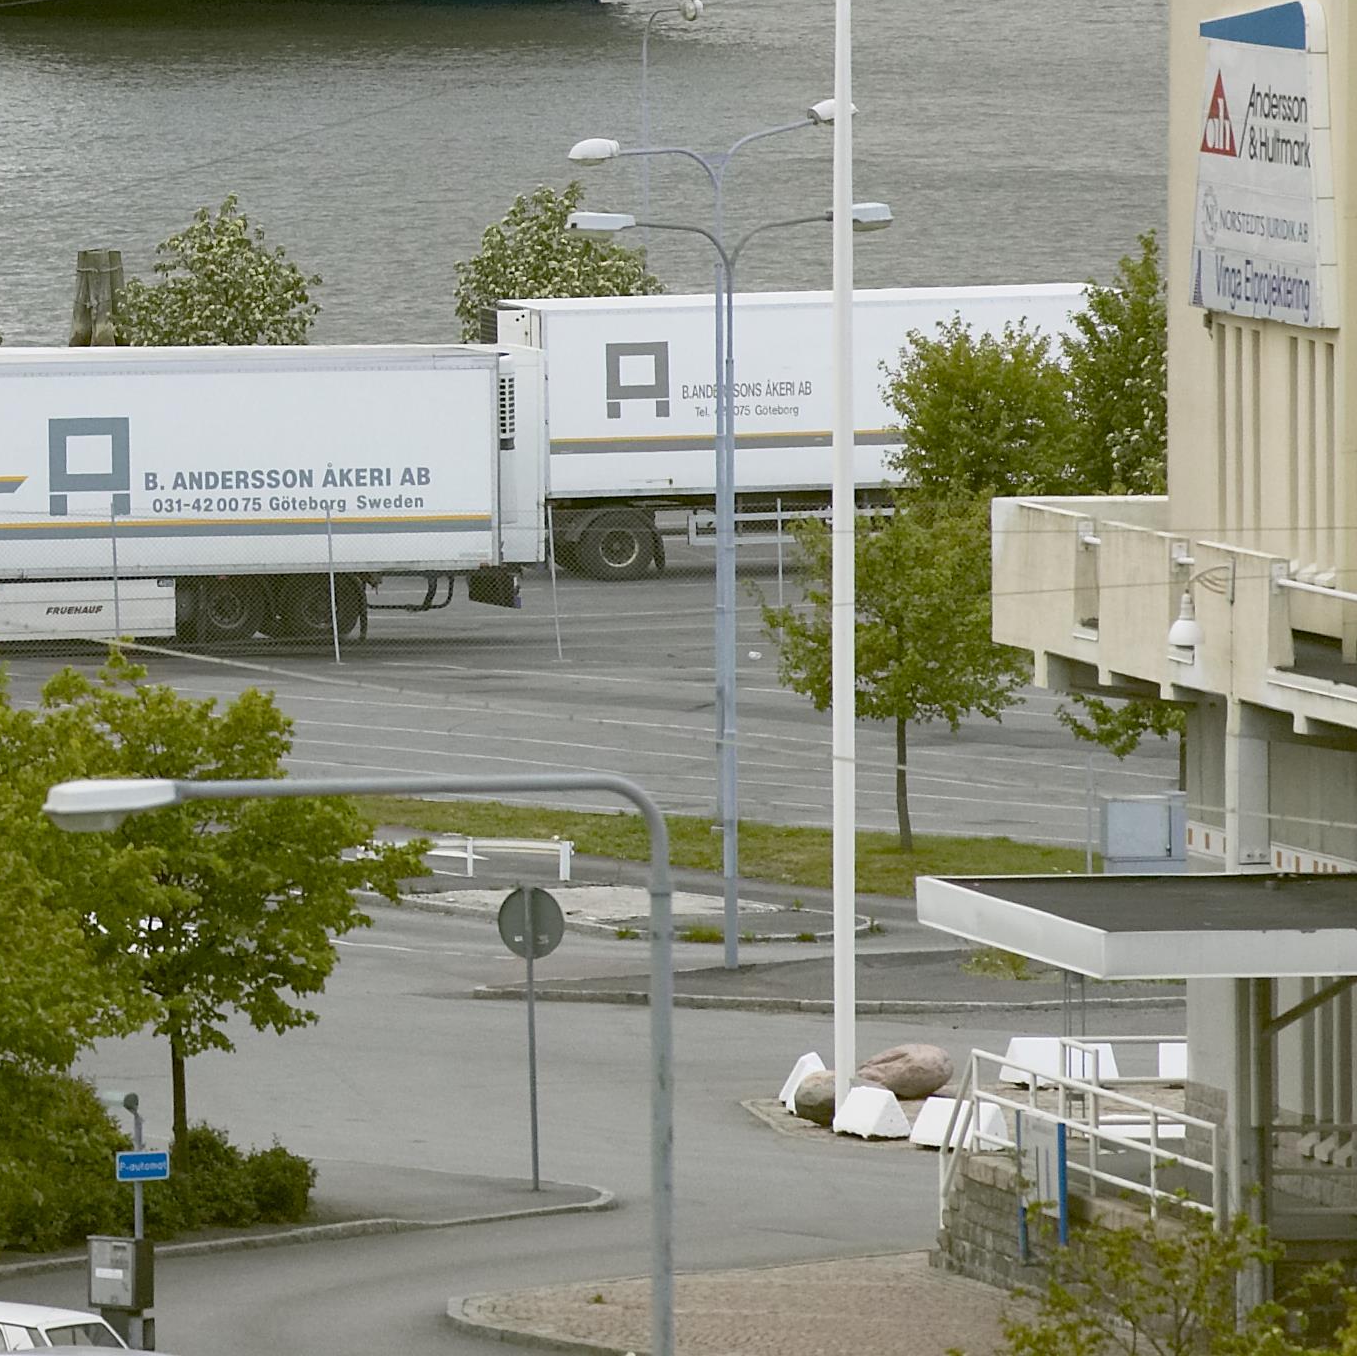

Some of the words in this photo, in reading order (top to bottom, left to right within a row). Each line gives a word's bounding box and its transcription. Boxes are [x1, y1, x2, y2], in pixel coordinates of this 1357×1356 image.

[1246, 83, 1308, 124] Andersson
[1248, 125, 1258, 160] &
[1259, 127, 1311, 169] Hultmark
[1219, 208, 1265, 237] NORSTEDTS
[1298, 222, 1309, 243] AB
[1215, 254, 1242, 311] Vinga
[1244, 259, 1310, 323] Elprojektering
[765, 379, 795, 397] ÅKERI
[798, 381, 812, 395] AB
[755, 404, 799, 416] Göteborg
[144, 472, 165, 490] B.
[172, 469, 314, 490] ANDERSSON
[322, 462, 391, 487] ÅKERI
[400, 467, 431, 486] AB
[269, 496, 347, 513] Göteborg
[356, 495, 424, 510] Sweden
[45, 605, 104, 615] FRUEHAUF
[119, 1161, 167, 1173] P-automat
